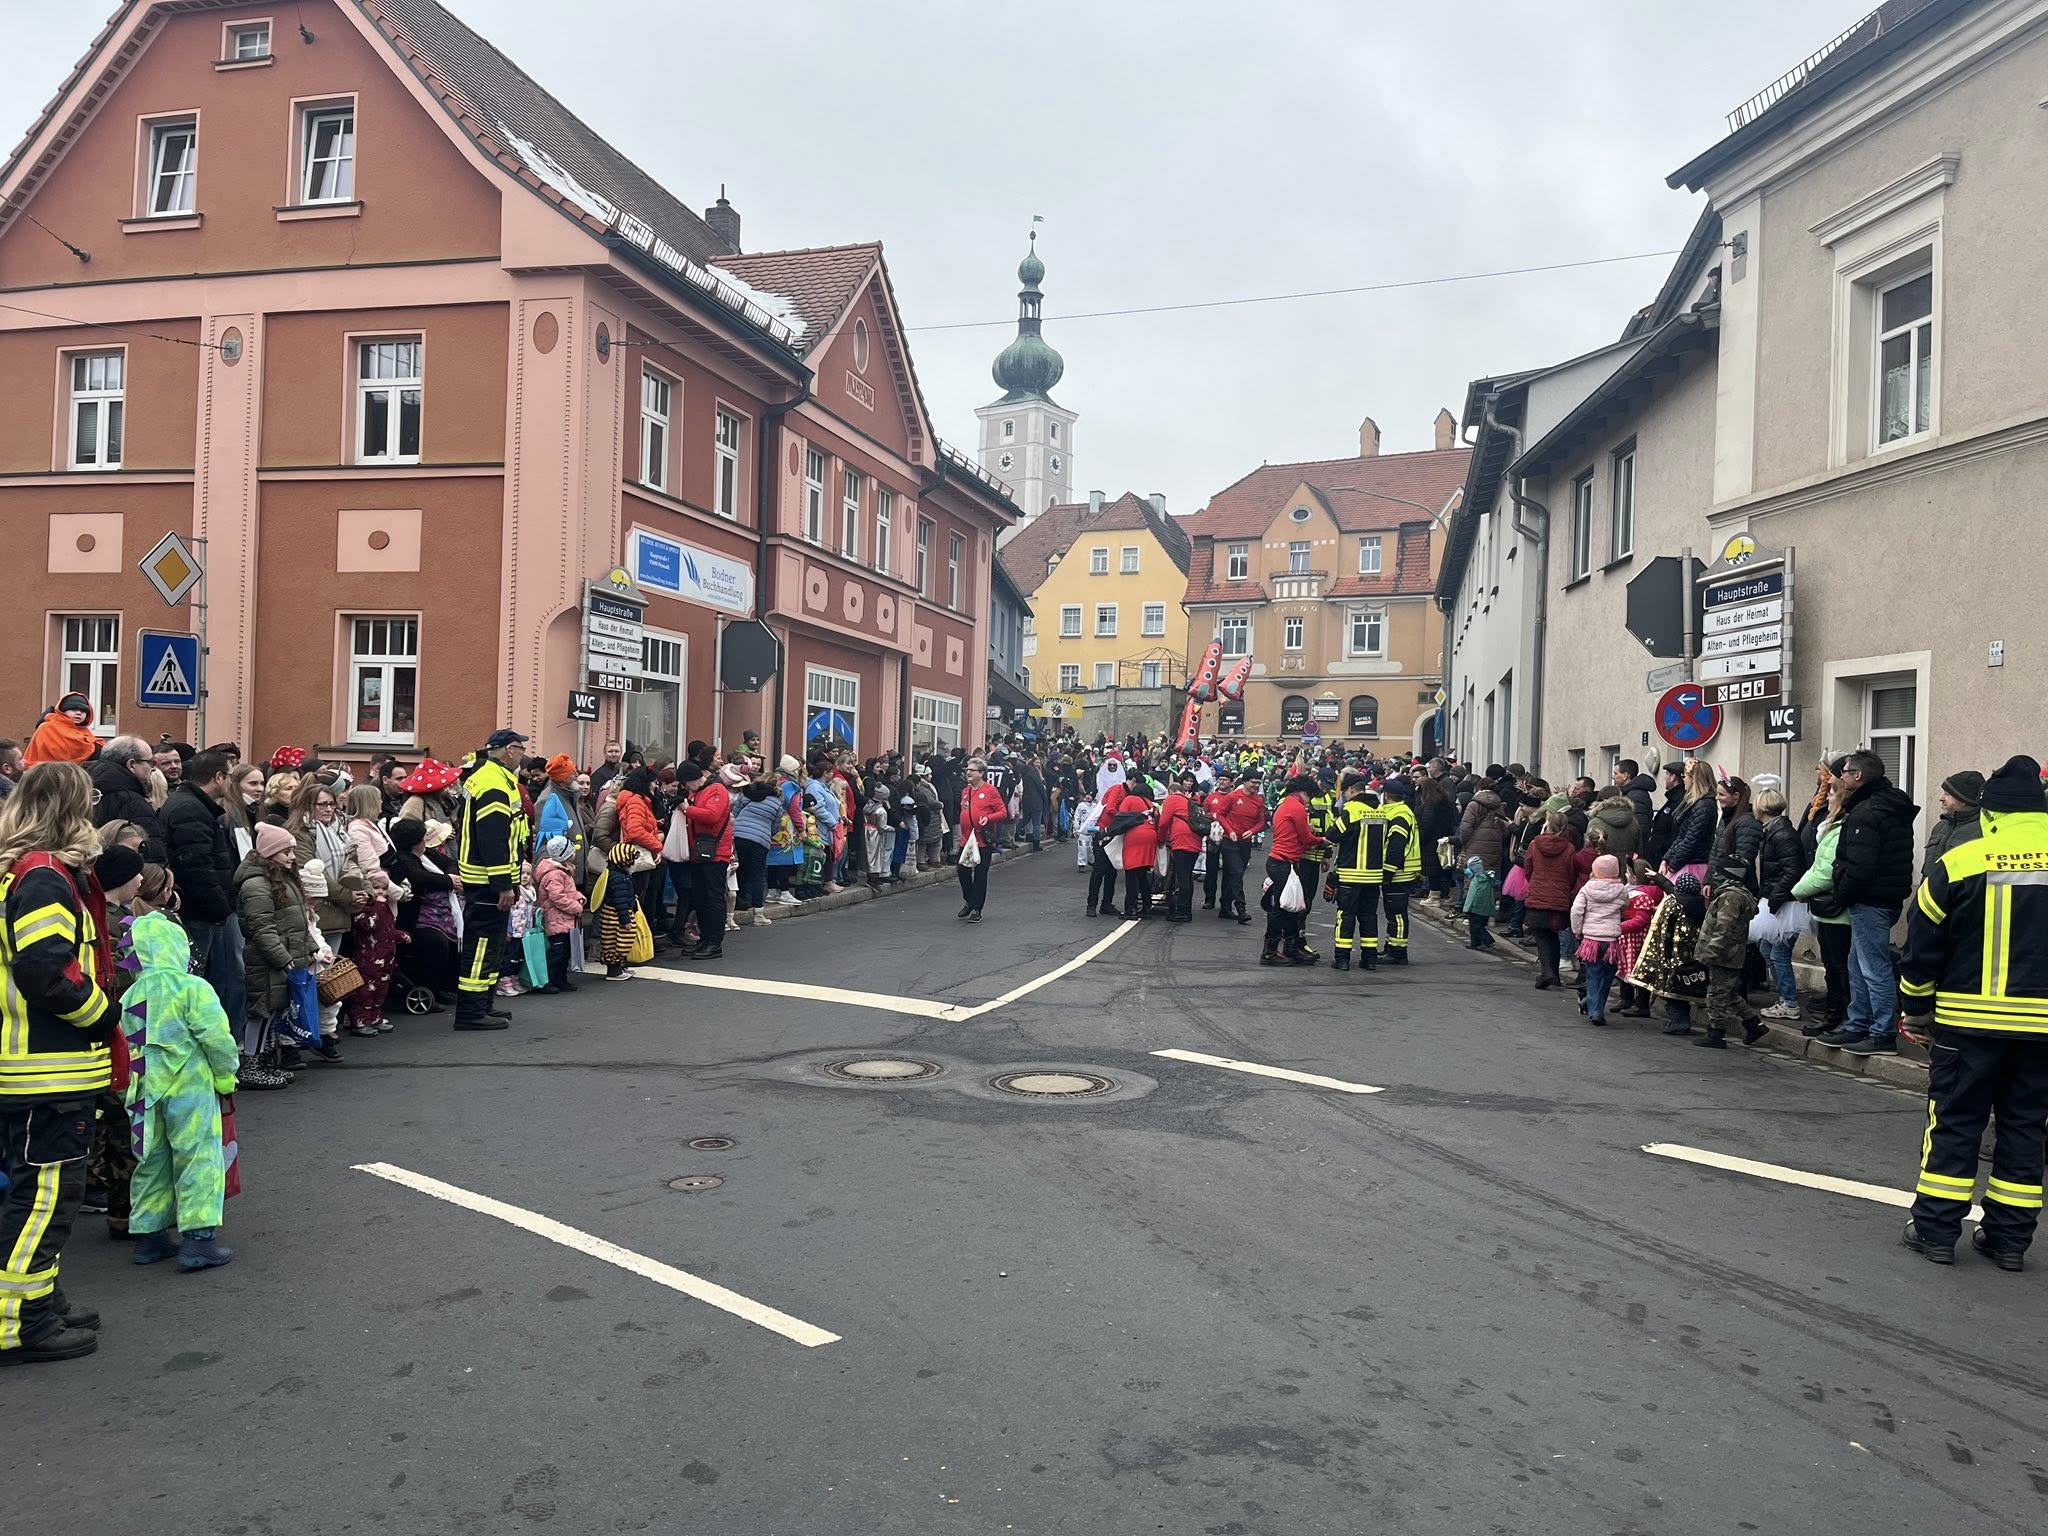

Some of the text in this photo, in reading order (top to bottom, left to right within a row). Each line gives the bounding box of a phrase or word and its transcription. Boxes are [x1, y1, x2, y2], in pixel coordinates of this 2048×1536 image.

[711, 566, 736, 585] Bodner
[702, 578, 743, 601] Buchhandlung
[1717, 581, 1769, 602] Hauptstraße
[599, 601, 634, 619] Hauptstraße
[1716, 606, 1769, 626] Haus der Heimat
[598, 620, 634, 636] Haus der Heimat
[607, 642, 616, 650] und
[616, 642, 640, 655] Pflegeheim
[1707, 630, 1778, 651] Alten- und Pflegeheim
[575, 694, 596, 709] WC
[1769, 708, 1795, 727] WC
[986, 771, 1003, 788] 87
[1985, 852, 2048, 861] Feuer
